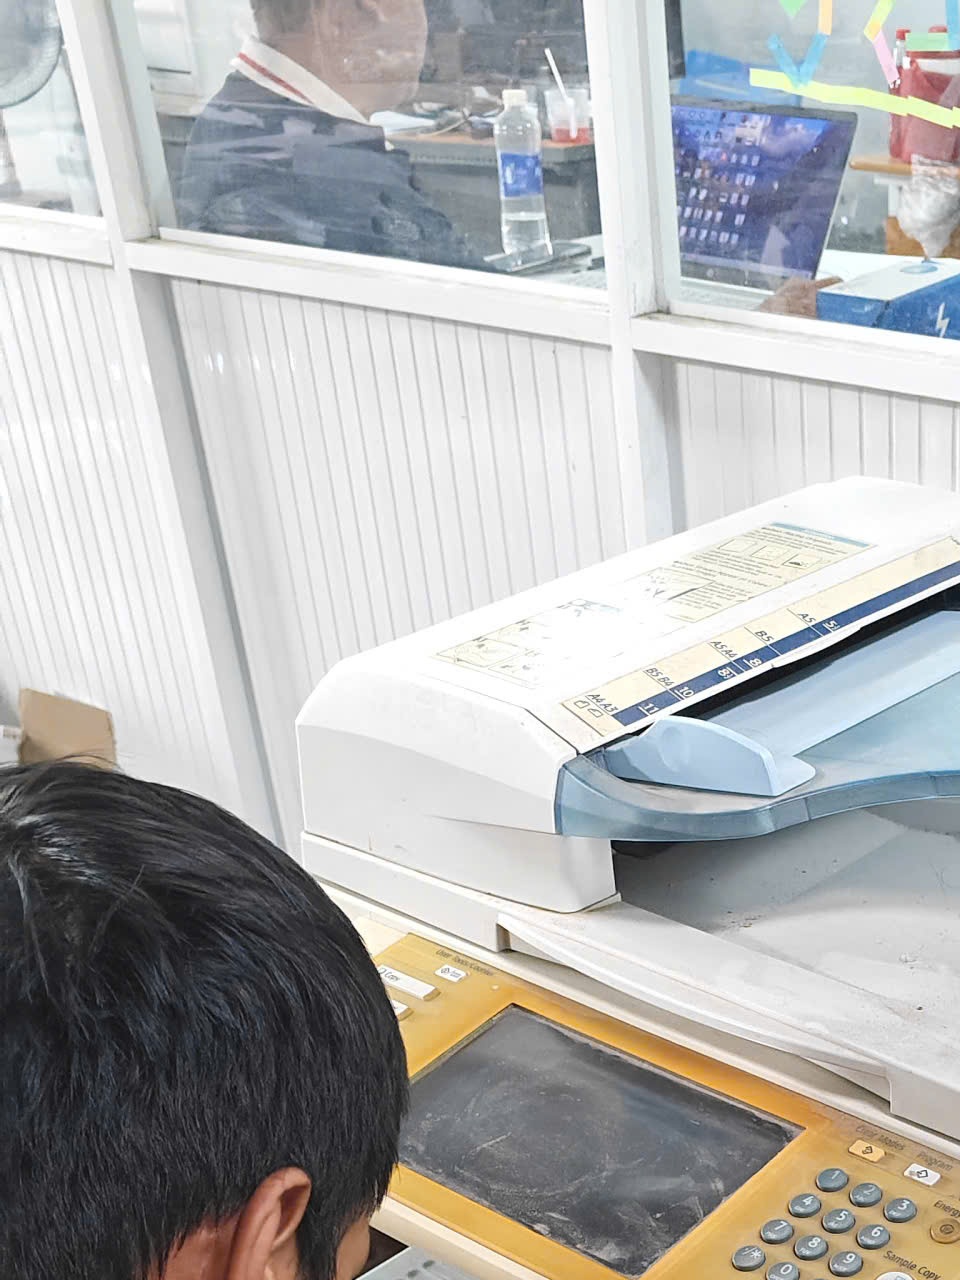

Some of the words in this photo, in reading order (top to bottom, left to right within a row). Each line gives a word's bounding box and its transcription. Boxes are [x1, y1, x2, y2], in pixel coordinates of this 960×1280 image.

[754, 629, 774, 643] B5
[917, 1151, 953, 1171] Program
[831, 1170, 841, 1180] 1
[863, 1184, 876, 1195] 2
[802, 1195, 814, 1206] 4
[897, 1199, 910, 1211] 3
[835, 1210, 849, 1222] 5
[774, 1221, 788, 1232] 7
[871, 1226, 884, 1238] 6
[808, 1236, 821, 1248] 8
[843, 1253, 856, 1264] 9
[883, 1250, 917, 1271] Sample
[780, 1264, 793, 1275] 0
